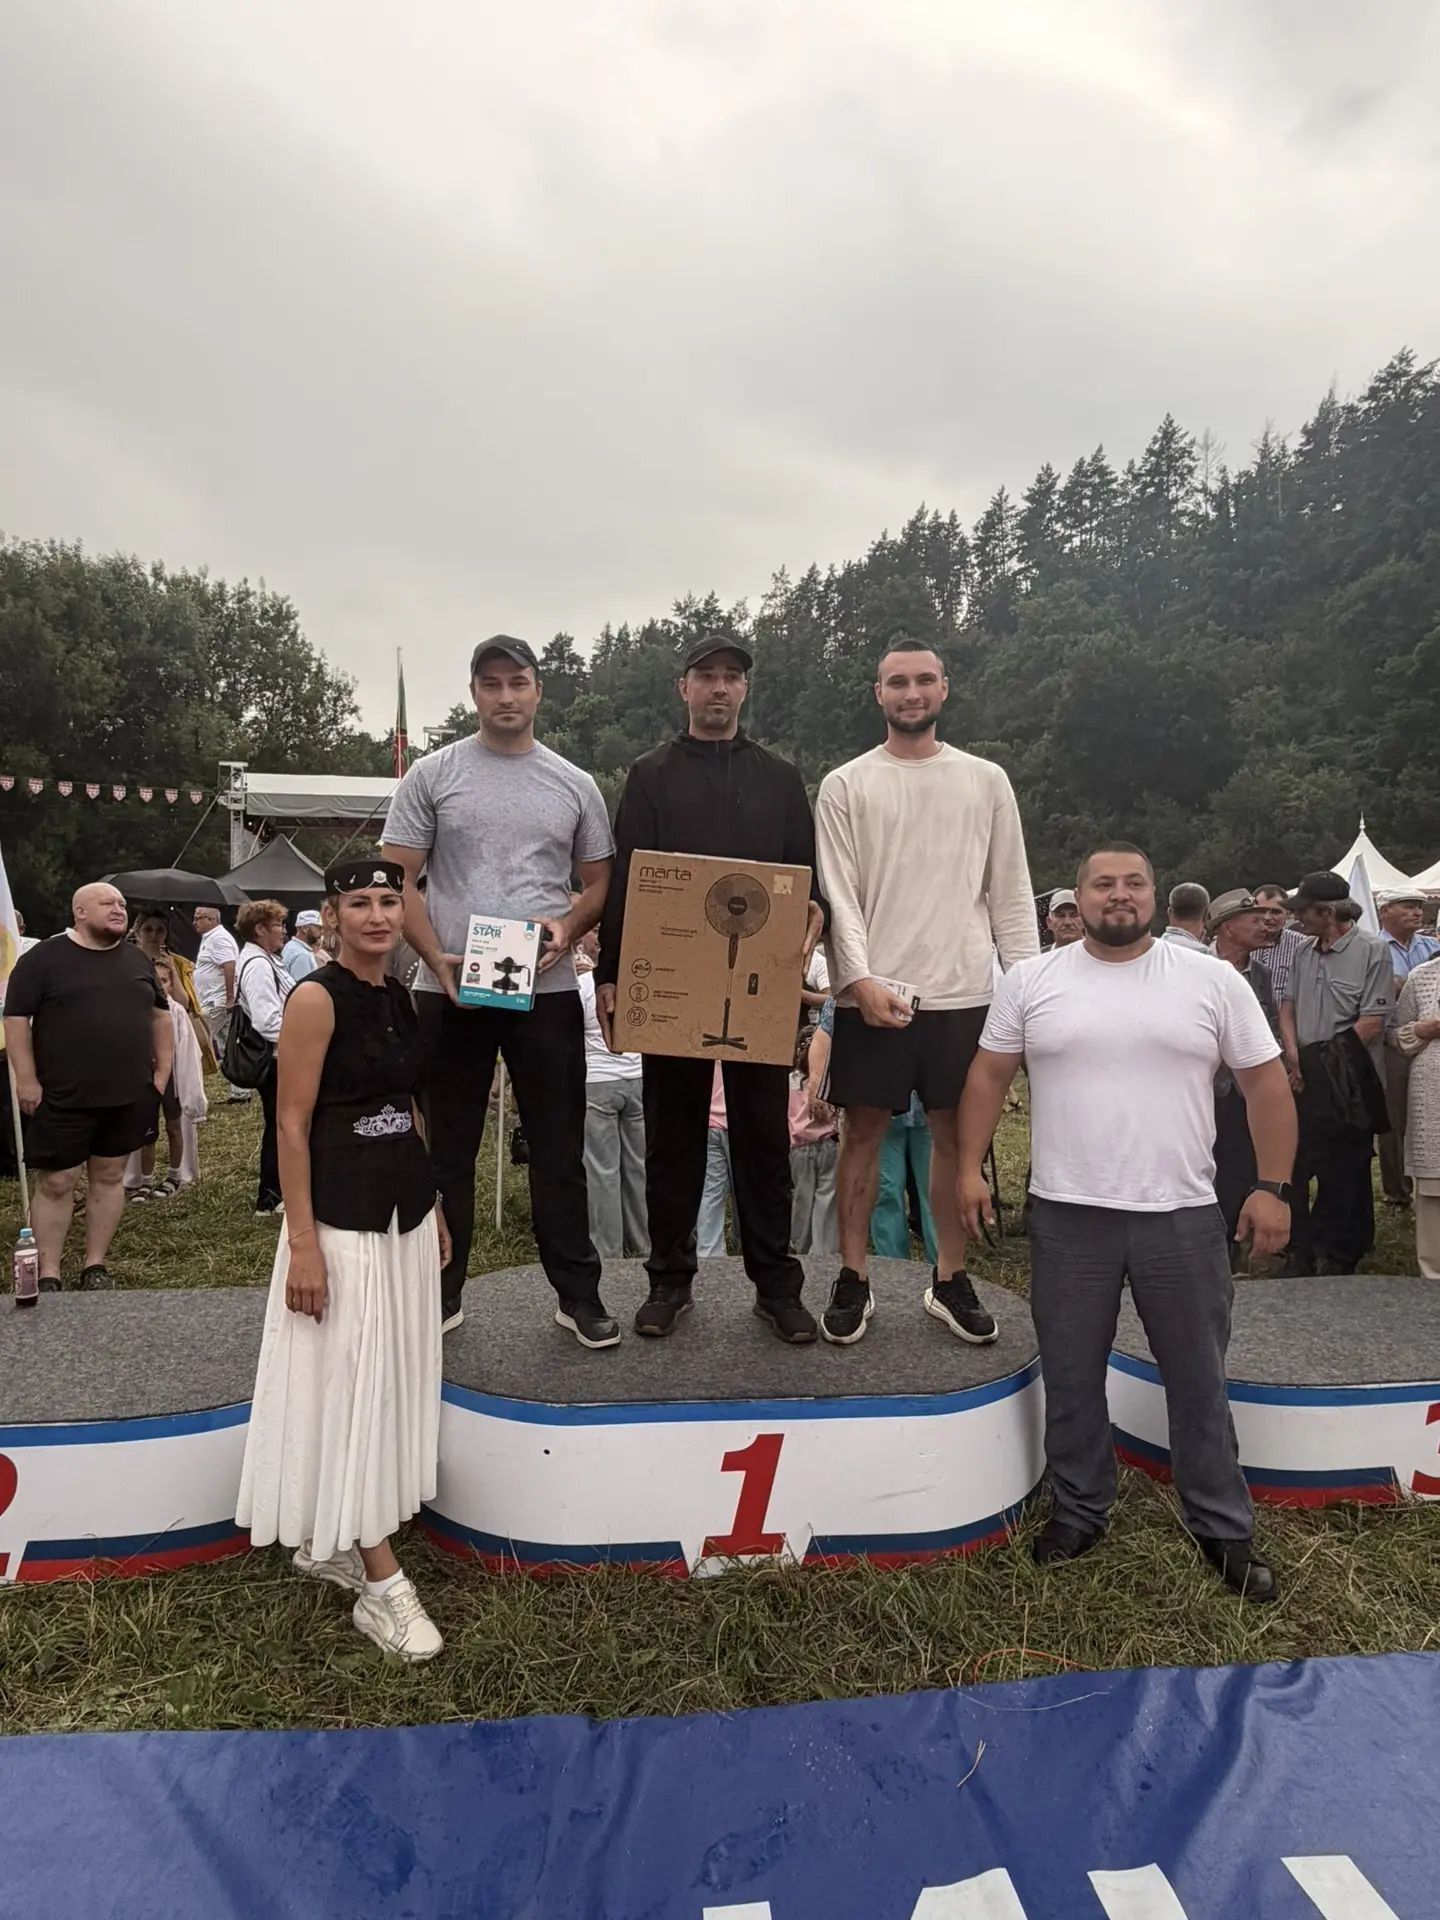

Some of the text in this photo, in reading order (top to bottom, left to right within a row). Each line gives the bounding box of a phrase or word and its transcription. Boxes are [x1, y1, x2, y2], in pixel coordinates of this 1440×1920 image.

[640, 866, 691, 881] marta
[473, 926, 501, 939] STAR
[701, 1433, 787, 1557] 1
